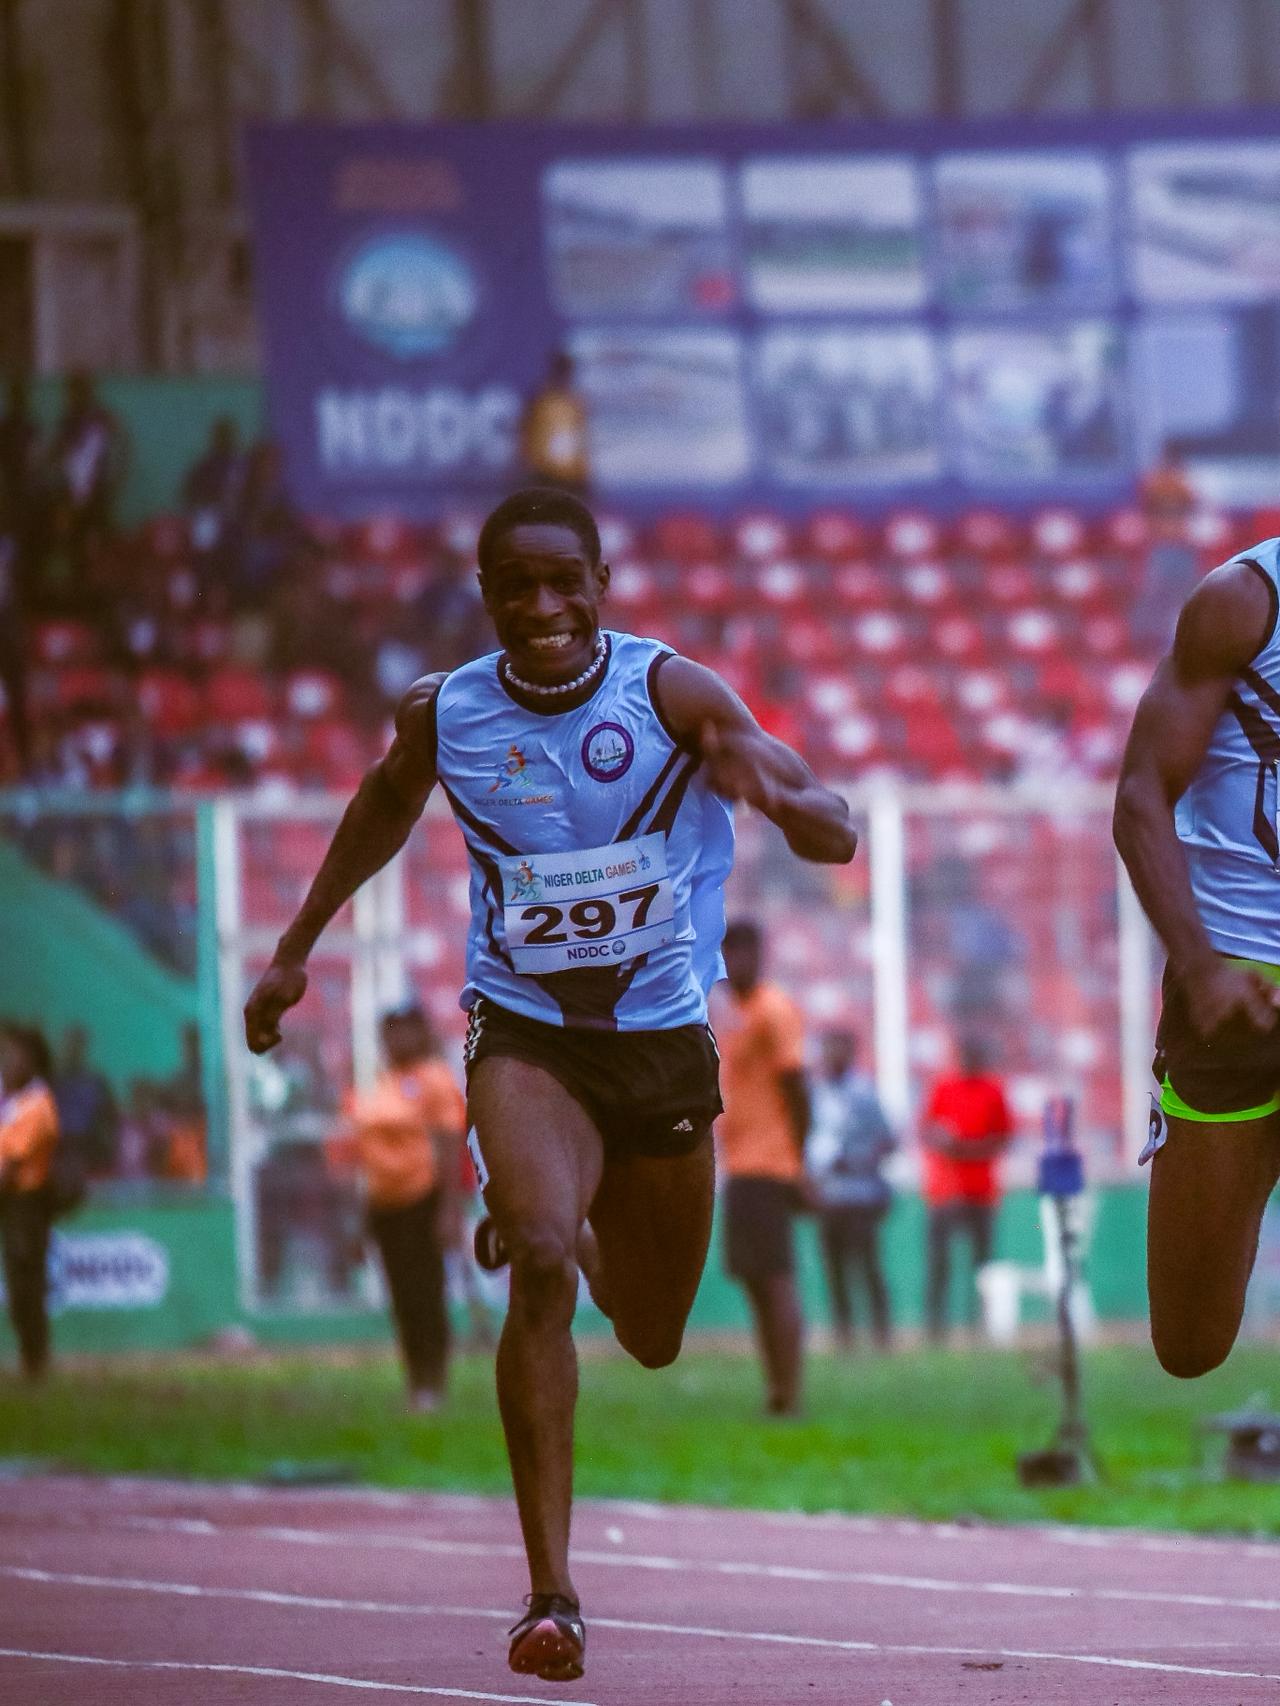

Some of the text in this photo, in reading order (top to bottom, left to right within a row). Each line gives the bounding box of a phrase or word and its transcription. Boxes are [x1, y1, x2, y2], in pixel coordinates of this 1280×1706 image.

[499, 797, 523, 807] DELTA
[544, 873, 574, 889] NIGER
[575, 868, 605, 884] DELTA
[605, 860, 637, 879] GAMES
[520, 883, 660, 945] 297
[567, 944, 611, 961] NDDC
